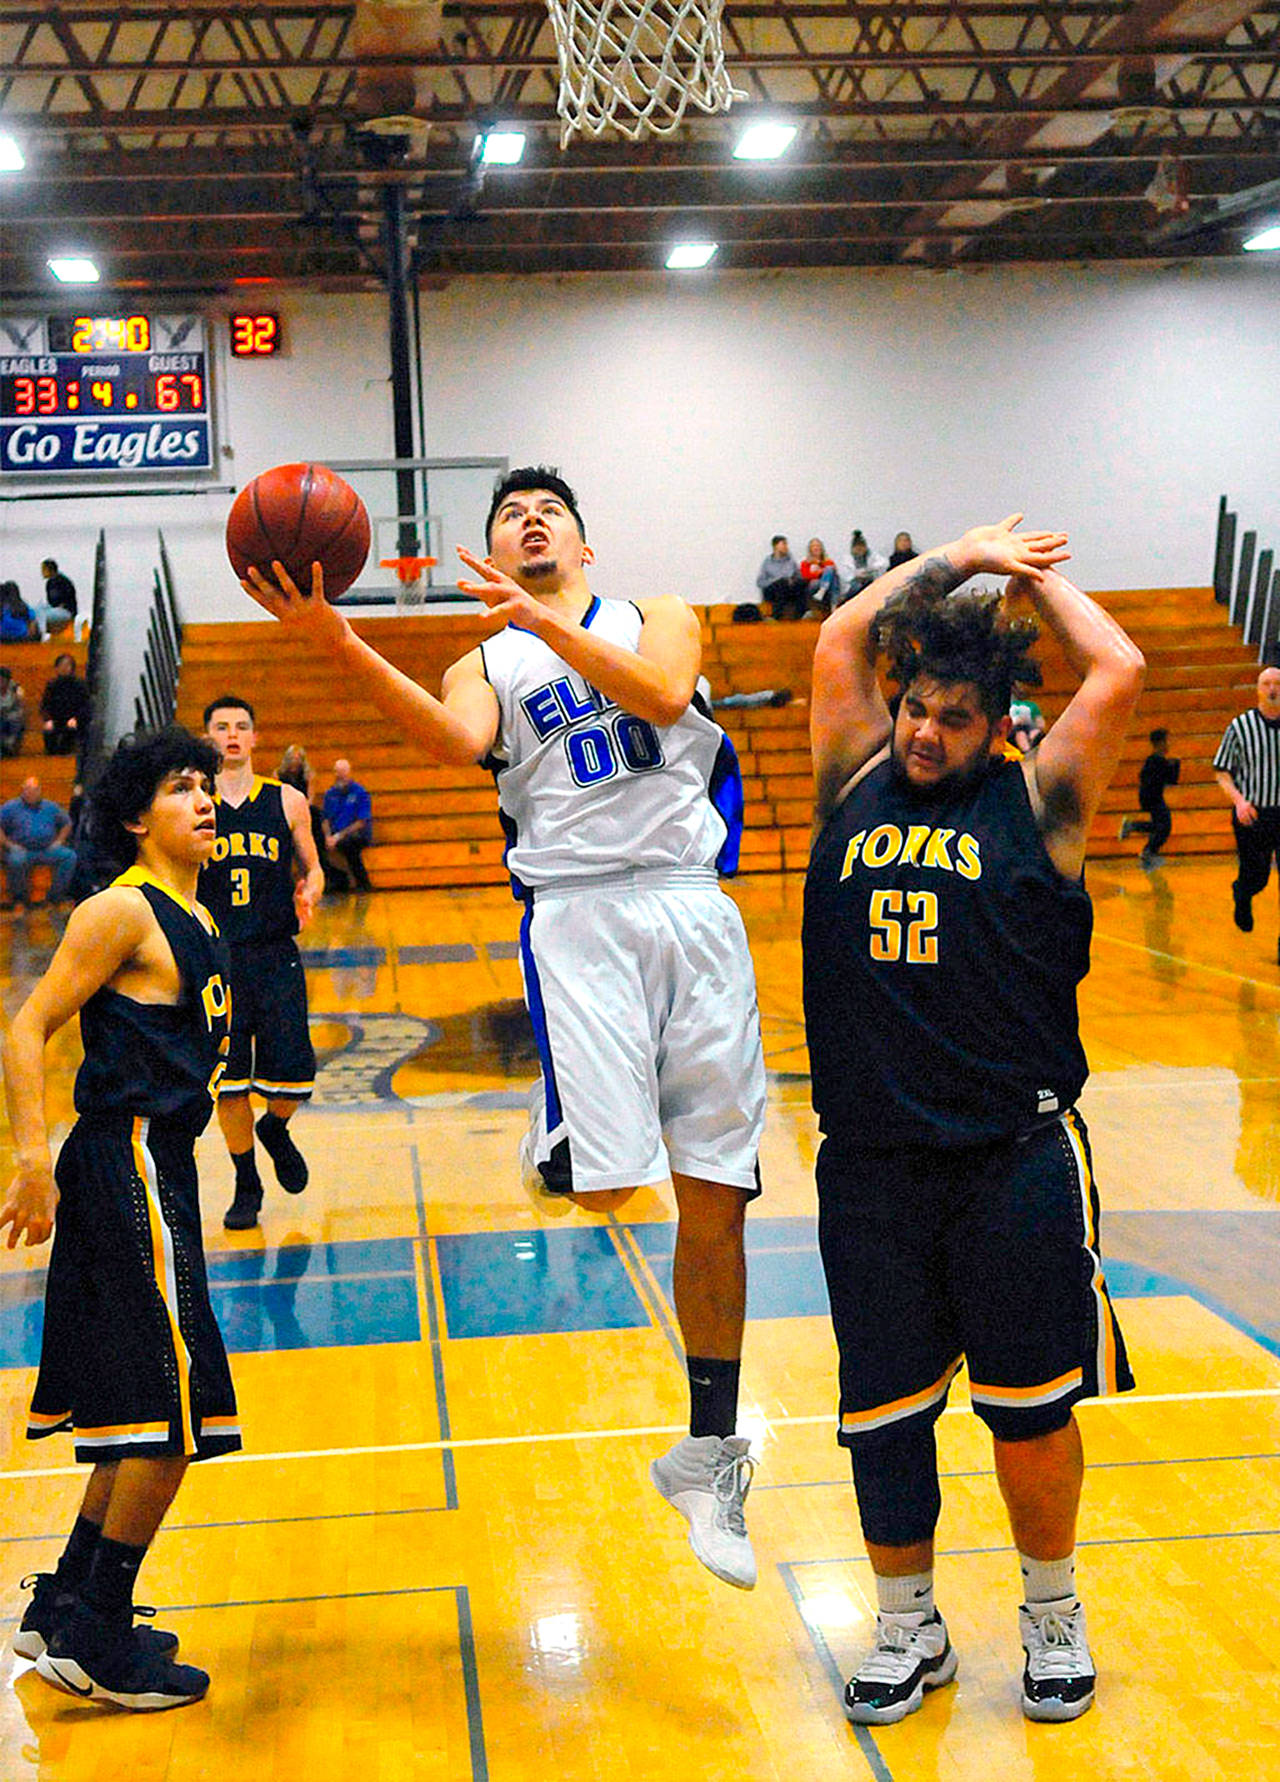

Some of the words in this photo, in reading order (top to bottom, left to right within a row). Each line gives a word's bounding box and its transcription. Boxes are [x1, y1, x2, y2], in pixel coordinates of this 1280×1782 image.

[233, 315, 275, 354] 32
[0, 357, 58, 375] EAGLES
[81, 364, 120, 377] PERIOD
[149, 354, 199, 371] GUEST
[14, 376, 58, 415] 33
[155, 373, 202, 411] 67
[7, 424, 61, 464] Go
[72, 423, 200, 467] Eagles
[564, 712, 666, 789] 00
[203, 832, 279, 870] ORKS
[839, 824, 982, 882] FORKS
[231, 868, 250, 906] 3
[869, 889, 939, 964] 52
